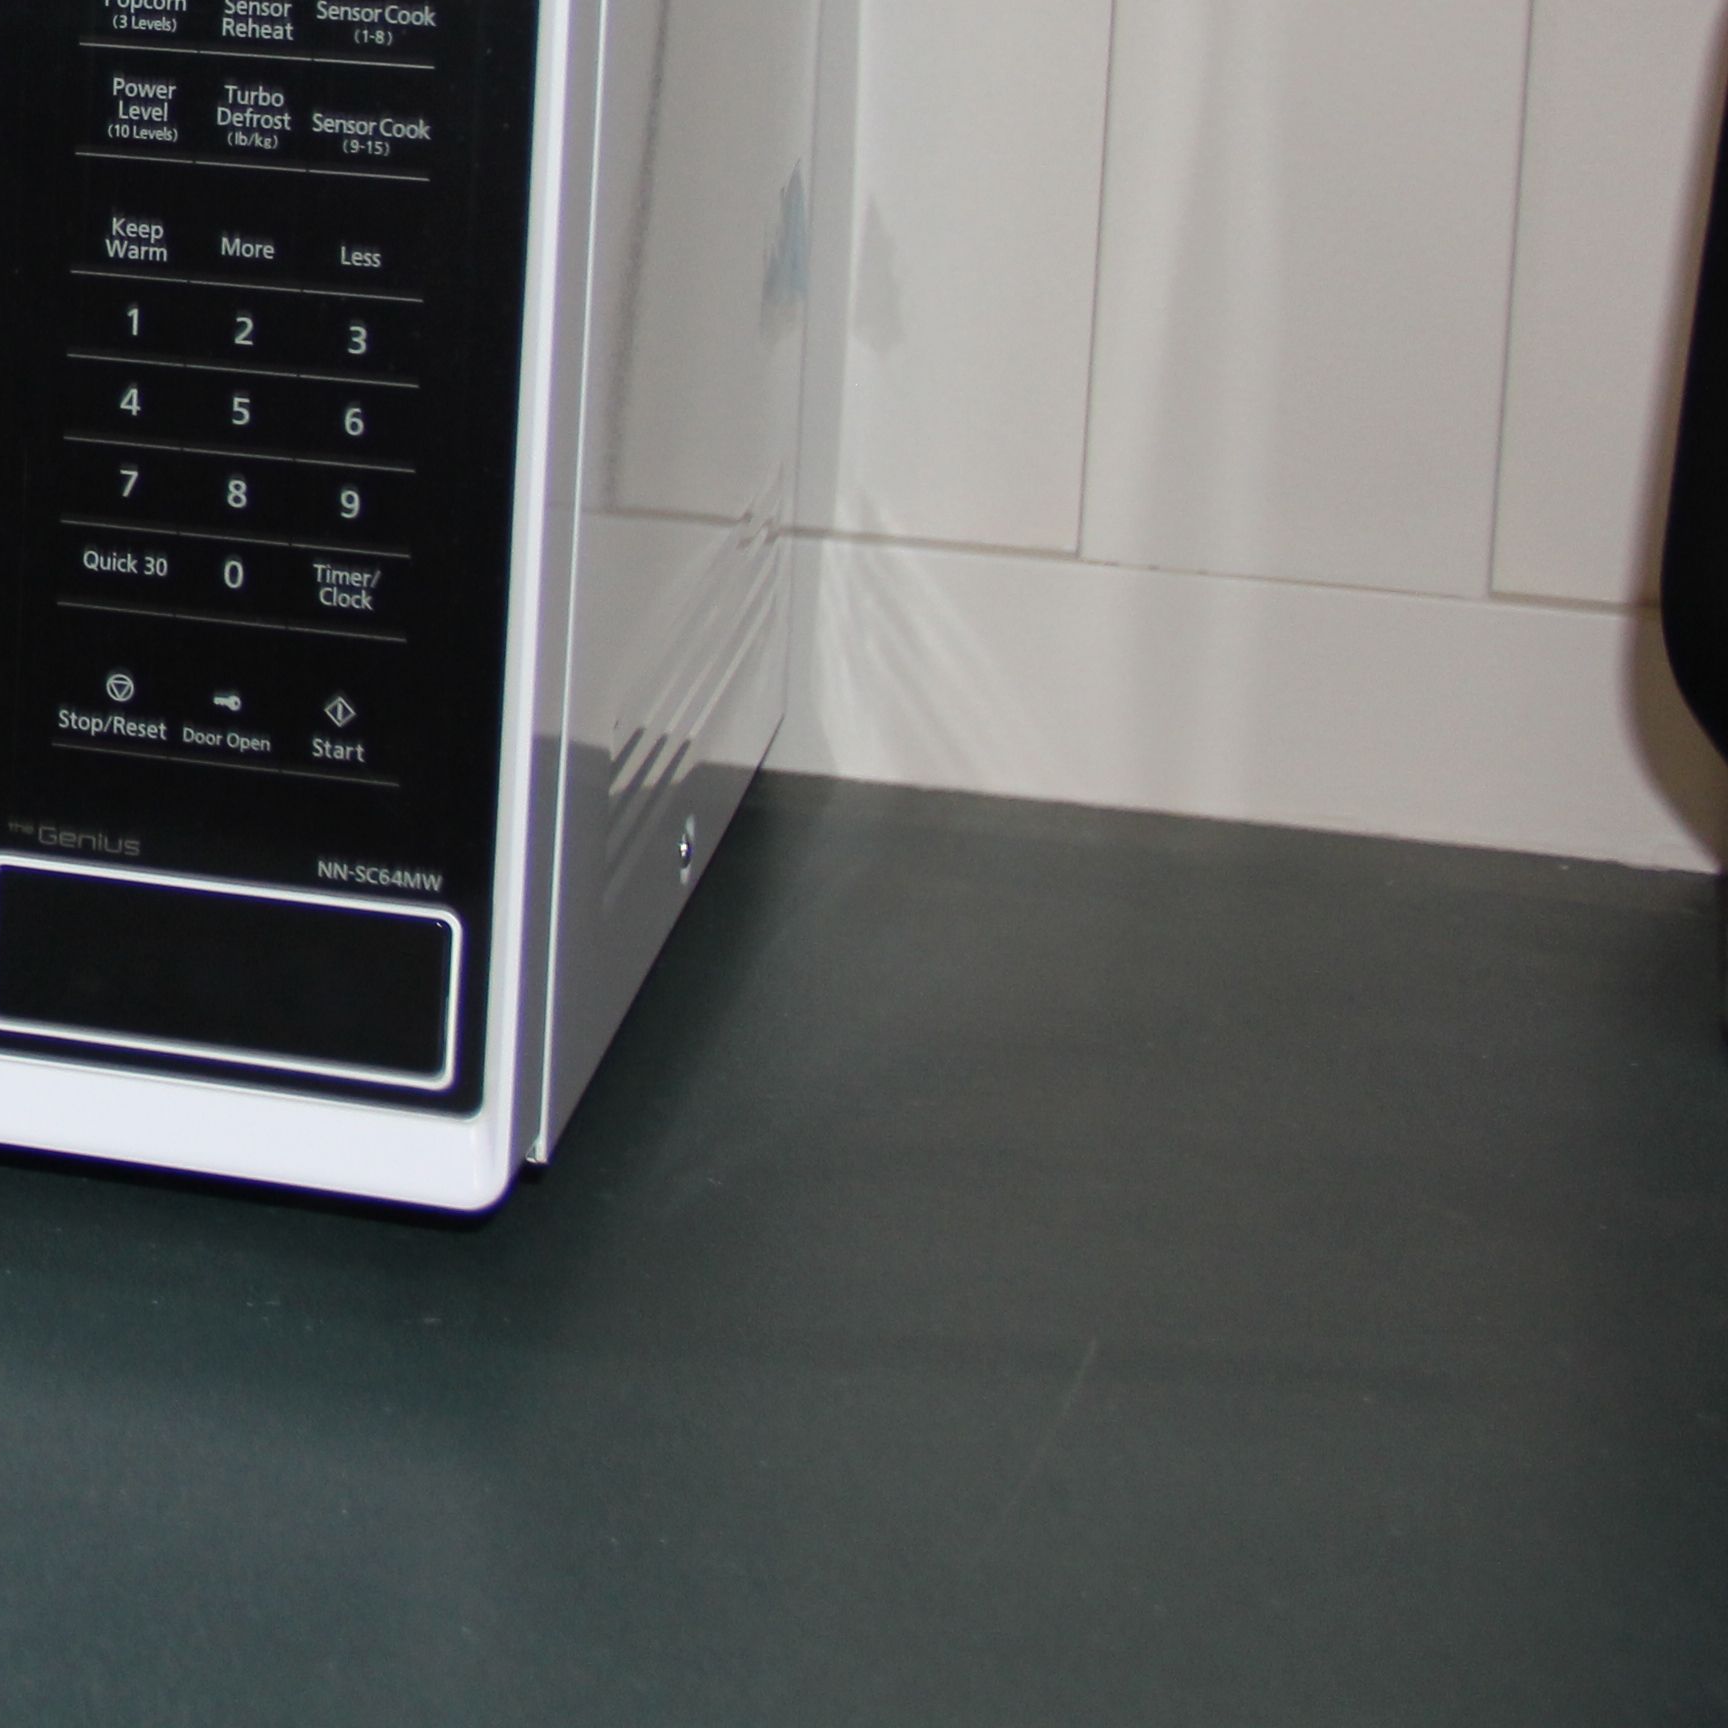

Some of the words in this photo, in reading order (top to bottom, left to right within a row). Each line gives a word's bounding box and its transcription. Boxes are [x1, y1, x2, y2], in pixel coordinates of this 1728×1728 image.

[112, 14, 128, 31] (3
[131, 16, 177, 33] Levels)
[316, 0, 383, 23] Sensor
[384, 4, 436, 28] Cook
[222, 18, 294, 41] Reheat
[354, 29, 393, 46] (1-8)
[112, 77, 176, 100] Power
[224, 84, 284, 107] Turbo
[118, 100, 168, 123] Level
[216, 108, 291, 131] Defrost
[108, 124, 130, 140] (10
[132, 124, 178, 143] Levels)
[312, 113, 377, 136] Sensor
[379, 118, 431, 141] Cook
[227, 132, 279, 150] (lb/kg)
[342, 140, 391, 157] (9-15)
[111, 217, 164, 244] Keep
[105, 239, 168, 263] Warm
[221, 236, 275, 260] More
[340, 246, 382, 268] Less
[126, 308, 139, 336] 1
[233, 317, 254, 346] 2
[347, 326, 367, 355] 3
[120, 388, 141, 417] 4
[232, 397, 251, 425] 5
[344, 407, 364, 436] 6
[119, 469, 139, 498] 7
[227, 480, 248, 508] 8
[340, 490, 360, 519] 9
[82, 550, 138, 575] Quick
[143, 555, 168, 577] 30
[223, 560, 244, 589] 0
[313, 563, 381, 589] Timer/
[319, 587, 373, 611] Clock
[58, 709, 168, 742] Stop/Reset
[182, 726, 223, 747] Door
[227, 732, 271, 754] Open
[312, 738, 366, 763] Start
[38, 826, 141, 857] Genius
[317, 860, 443, 893] NN-SC64MW
